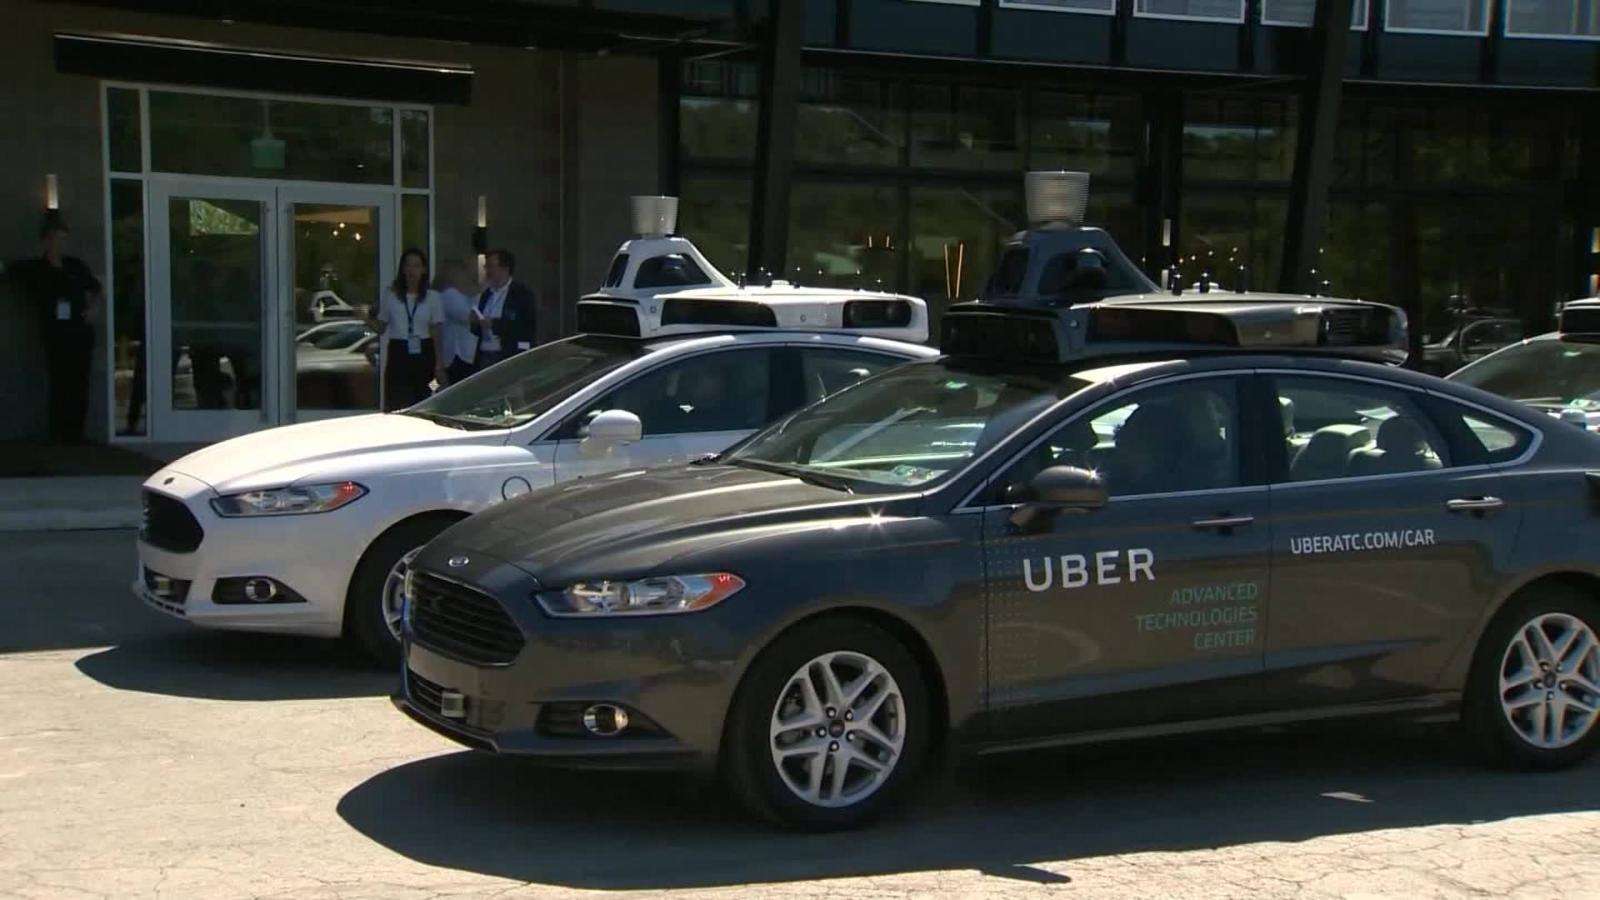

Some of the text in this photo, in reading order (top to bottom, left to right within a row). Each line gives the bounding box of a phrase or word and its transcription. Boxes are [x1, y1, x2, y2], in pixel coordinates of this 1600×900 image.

[1290, 529, 1436, 554] UBERATC.COM/CAR
[1023, 548, 1156, 592] UBER
[1171, 582, 1258, 605] ADVANCED
[1135, 606, 1258, 632] TECHNOLOGIES
[1194, 629, 1256, 649] CENTER
